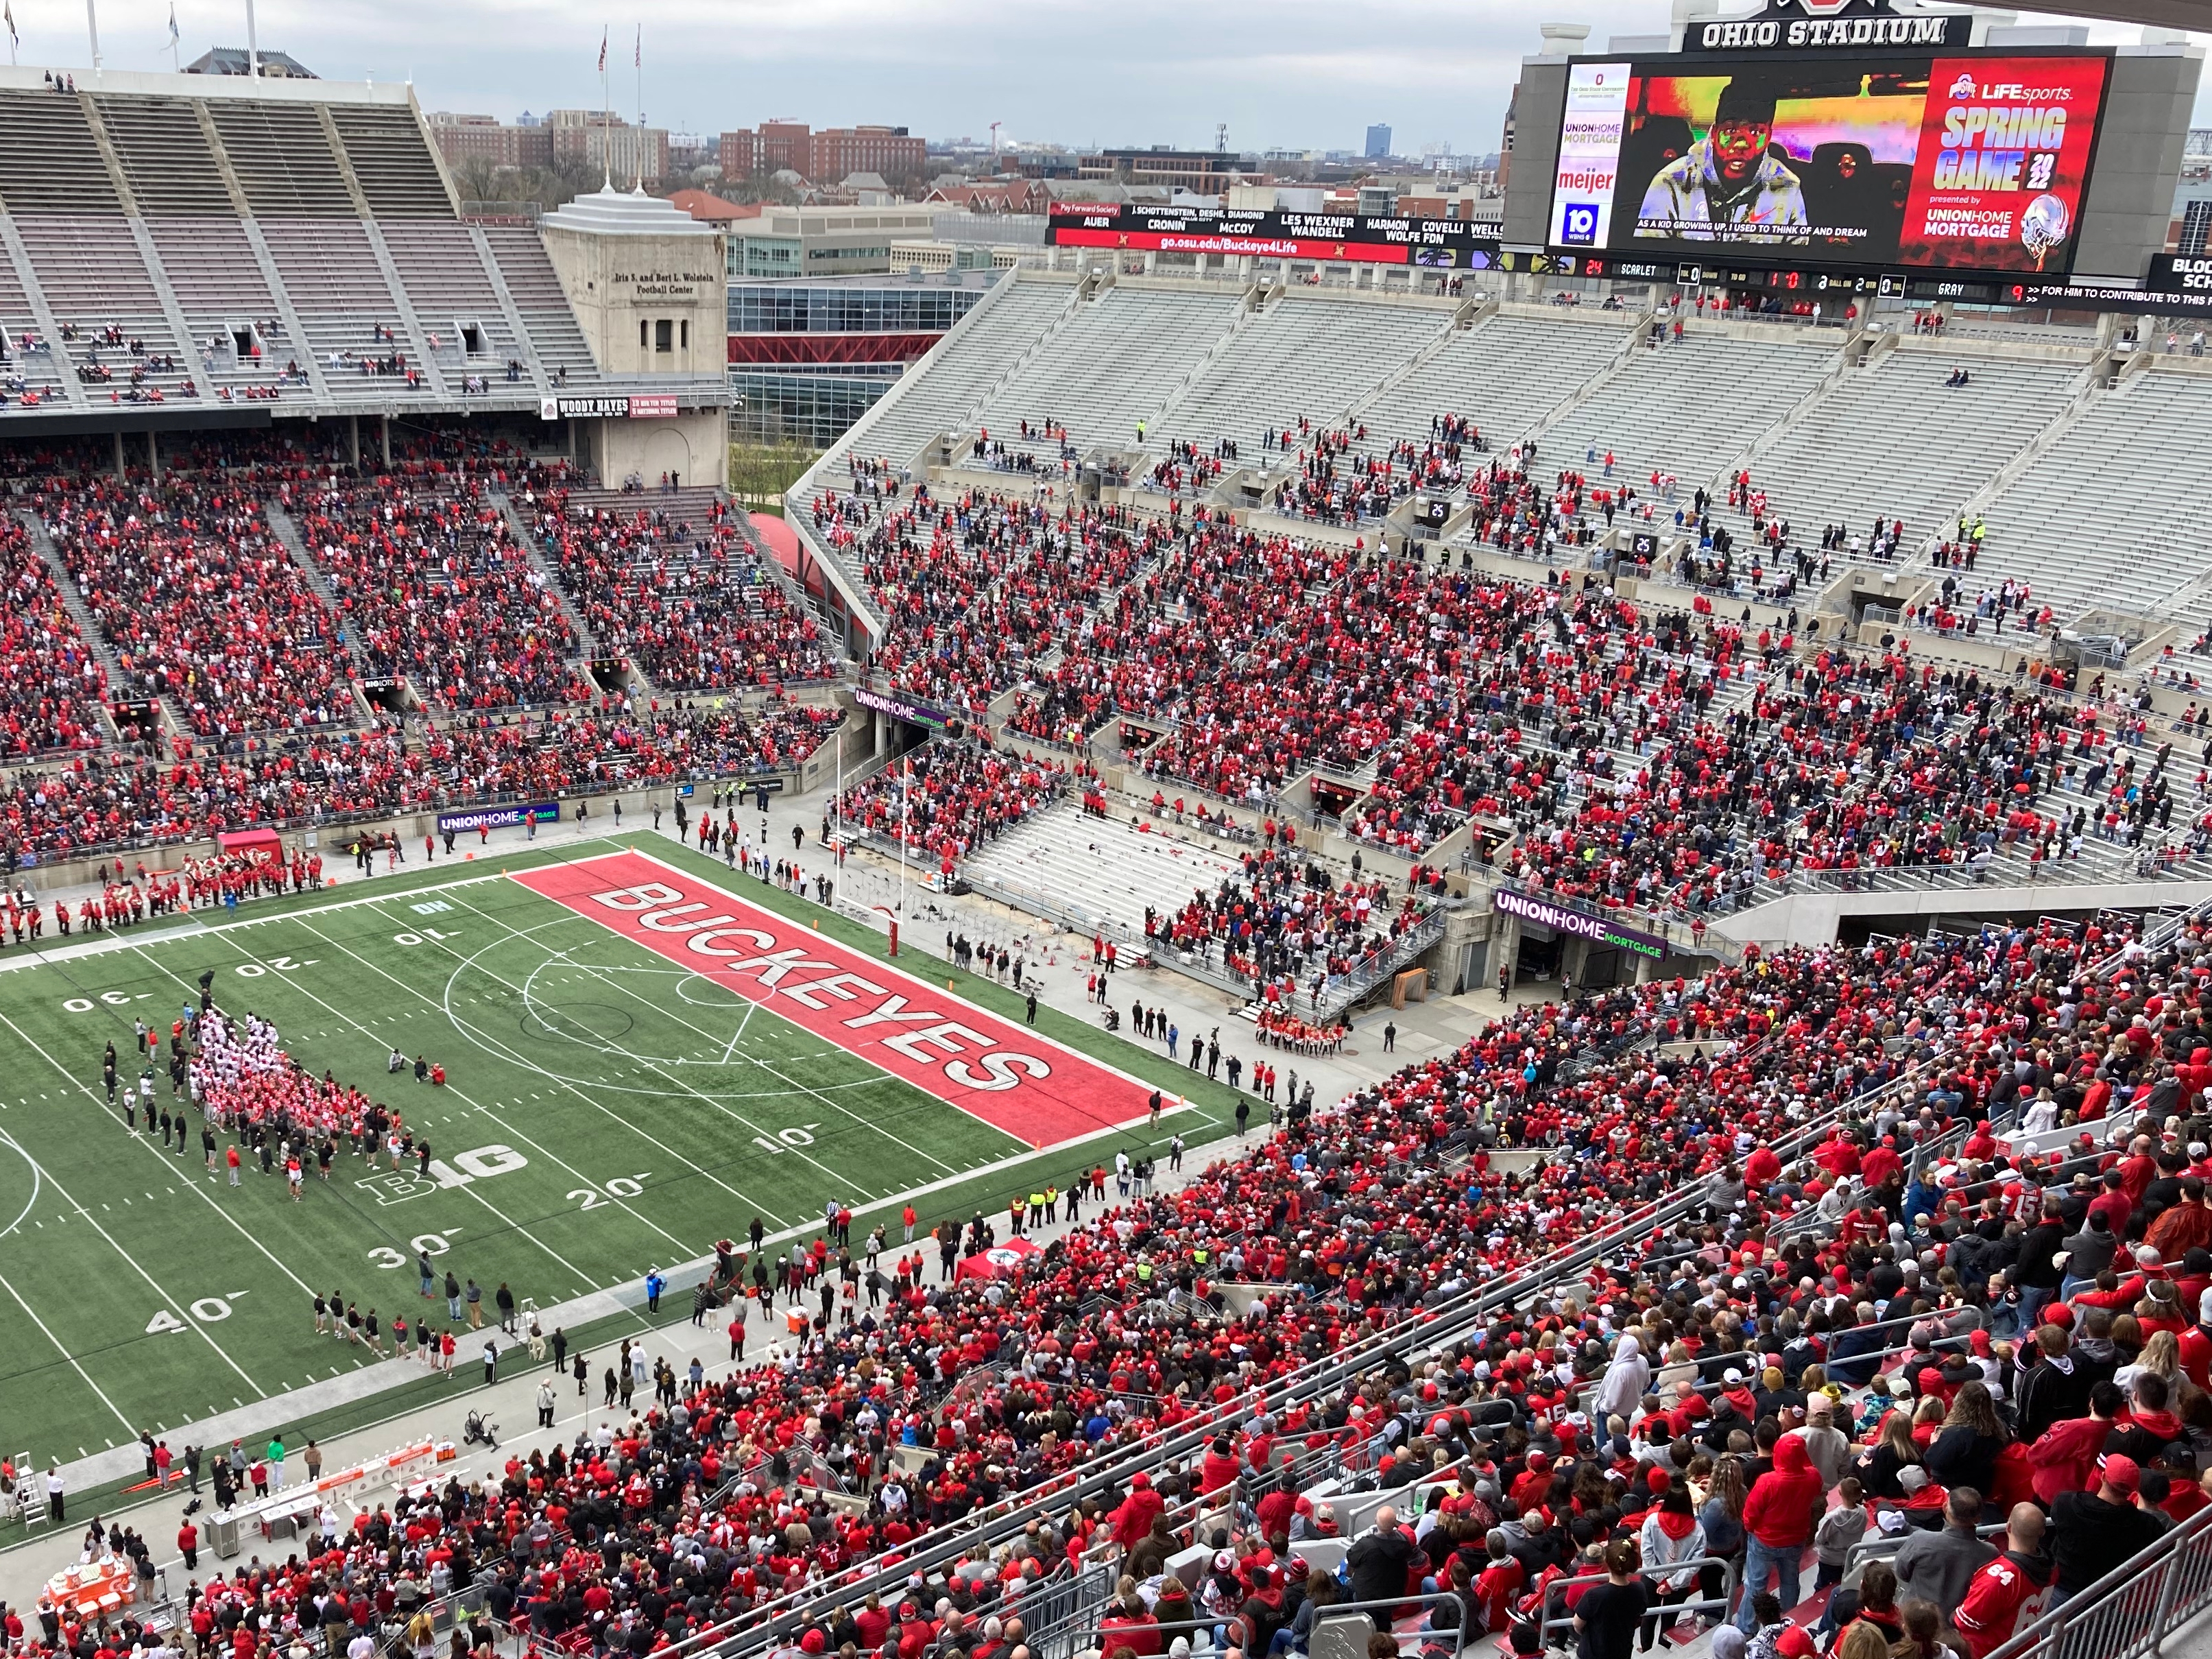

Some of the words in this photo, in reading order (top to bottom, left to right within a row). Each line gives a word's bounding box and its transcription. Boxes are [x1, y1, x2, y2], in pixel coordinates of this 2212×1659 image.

[1703, 22, 1780, 48] OHIO
[1788, 18, 1948, 46] STADIUM
[1566, 123, 1621, 133] UNIONHOME
[1940, 106, 2067, 149] SPRING
[1564, 134, 1619, 144] MORTGAGE
[1933, 150, 2025, 191] GAME
[1559, 167, 1613, 194] meijer
[1930, 195, 1969, 204] presented
[1971, 197, 1981, 205] by
[1060, 204, 1071, 213] Pay
[1072, 204, 1096, 213] Forward
[1096, 206, 1118, 215] Society
[1199, 208, 1226, 219] DESHE,
[1227, 211, 1265, 220] DIAMOND
[1927, 208, 2013, 224] UNIONHOME
[1083, 216, 1109, 228] AUER
[1147, 219, 1186, 232] CRONIN
[1218, 222, 1255, 235] McCOY
[1281, 215, 1301, 226] LES
[1303, 215, 1354, 228] WEXNER
[1367, 219, 1409, 231] HARMON
[1422, 221, 1464, 234] COVELLI
[1568, 209, 1593, 234] 10
[1637, 219, 1648, 228] AS
[1658, 220, 1672, 228] KID
[1673, 222, 1712, 230] GROWING
[1714, 223, 1727, 232] UP,
[1734, 224, 1756, 232] USED
[1758, 225, 1770, 233] TO
[1772, 225, 1798, 235] THINK
[1799, 226, 1812, 235] OF
[1814, 227, 1833, 236] AND
[1835, 228, 1867, 237] DREAM
[1291, 225, 1345, 238] WANDELL
[1386, 230, 1421, 243] WOLFE
[1423, 232, 1444, 245] FDN
[1924, 222, 2011, 239] MORTGAGE
[1161, 237, 1297, 254] go.osu.edu/Buckeye4Life
[1586, 259, 1602, 275] 24
[1621, 263, 1657, 276] SCARLET
[1691, 267, 1699, 281] 0
[615, 273, 629, 282] Iris
[631, 273, 638, 282] S.
[639, 273, 653, 282] and
[656, 273, 671, 282] Bert
[673, 273, 682, 282] L.
[683, 273, 714, 282] Wolstein
[636, 285, 667, 294] Football
[669, 285, 693, 294] Center
[1938, 283, 1964, 295] GRAY
[2041, 286, 2063, 296] FOR
[2064, 287, 2082, 297] HIM
[2085, 289, 2097, 298] TO
[2100, 289, 2165, 303] CONTRIBUTE
[2167, 294, 2180, 303] TO
[2183, 295, 2206, 305] THIS
[559, 400, 594, 412] WOODY
[597, 399, 628, 412] HAYES
[1432, 504, 1443, 517] 25
[1637, 538, 1649, 551] 25
[856, 690, 915, 720] UNIONHOME
[914, 714, 946, 728] MORTGAGE
[1325, 785, 1355, 798] HONDA
[442, 811, 519, 829] UNIONHOME
[518, 811, 556, 821] MTGAGE
[1497, 892, 1607, 940] UNIONHOME
[1604, 933, 1662, 958] MORTGAGE
[589, 881, 1052, 1092] BUCKEYES
[1977, 1085, 1986, 1097] 2
[752, 1128, 814, 1154] 10
[566, 1178, 644, 1211] 20
[2015, 1195, 2039, 1218] 15
[368, 1234, 450, 1269] 30
[145, 1296, 232, 1334] 40
[1543, 1403, 1565, 1423] 16
[842, 1523, 850, 1534] 7
[1987, 1564, 2015, 1586] 64
